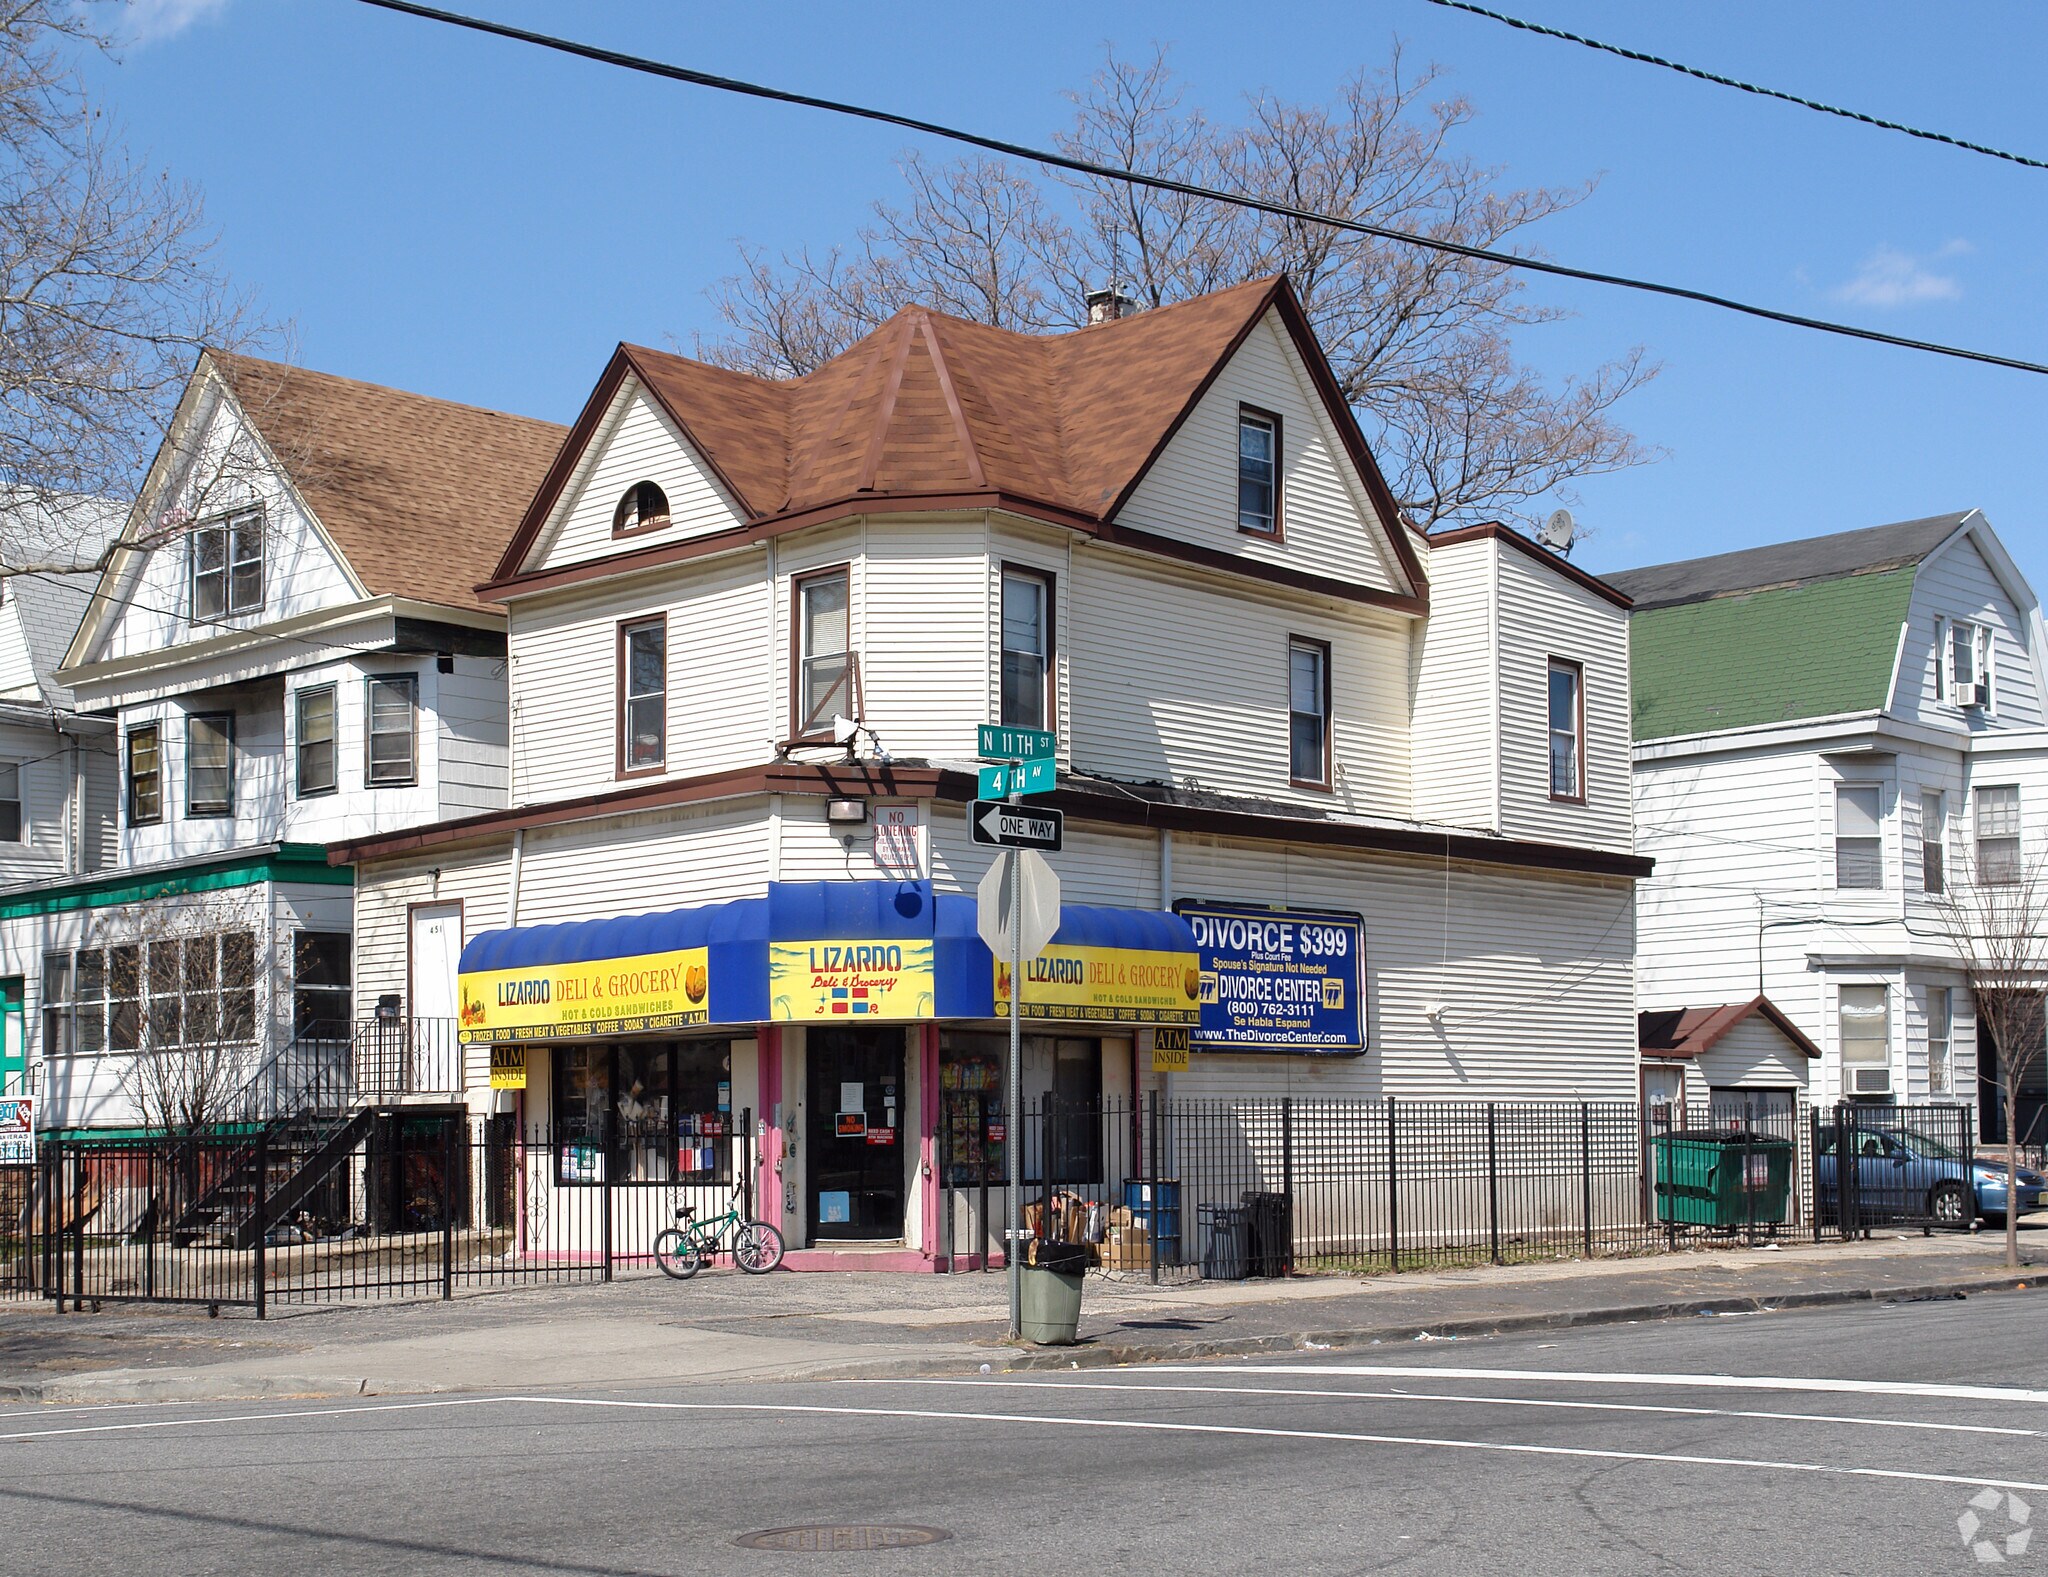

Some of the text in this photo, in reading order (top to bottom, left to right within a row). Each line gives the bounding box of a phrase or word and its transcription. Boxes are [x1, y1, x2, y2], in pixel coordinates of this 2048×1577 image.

[984, 731, 1050, 755] N 11TH ST
[992, 766, 1042, 791] 4TH AV
[889, 811, 904, 823] NO
[876, 825, 917, 837] LOITERING
[1000, 817, 1053, 838] ONE WAY
[1192, 917, 1347, 957] DIVORCE $399
[810, 945, 901, 973] LIZARDO
[1251, 951, 1292, 961] Plus Court Fee
[1028, 957, 1183, 988] LIZARDO DELI & GROCERY
[1213, 957, 1327, 975] Spouse's Signature Not Needed
[498, 962, 683, 1006] LIZARDO DELI & GROCERY
[811, 974, 897, 991] Deli & Grocery
[1220, 975, 1272, 1001] DIVORCE
[1093, 994, 1107, 1002] HOT
[1115, 995, 1133, 1004] COLD
[1135, 996, 1176, 1005] SANDWICHES
[562, 1000, 673, 1020] HOT & COLD SANDWICHES
[1084, 1007, 1114, 1019] VEGETABLES
[1118, 1009, 1136, 1020] COFFEE
[1227, 1001, 1314, 1017] (800) 762-3111
[472, 1030, 493, 1042] FROZEN
[496, 1029, 511, 1041] FOOD
[515, 1027, 533, 1039] FRESH
[534, 1026, 549, 1037] MEAT
[550, 1026, 555, 1036] &
[556, 1023, 591, 1036] VEGETABLES
[596, 1020, 619, 1033] COFFEE
[624, 1018, 644, 1031] SODAS
[649, 1015, 683, 1029] CIGARETTE
[1234, 1016, 1310, 1029] Se Habla Espanol
[1156, 1030, 1186, 1049] ATM
[492, 1047, 523, 1066] ATM
[1155, 1051, 1187, 1063] INSIDE
[492, 1068, 524, 1081] INSIDE
[846, 1115, 856, 1124] NO
